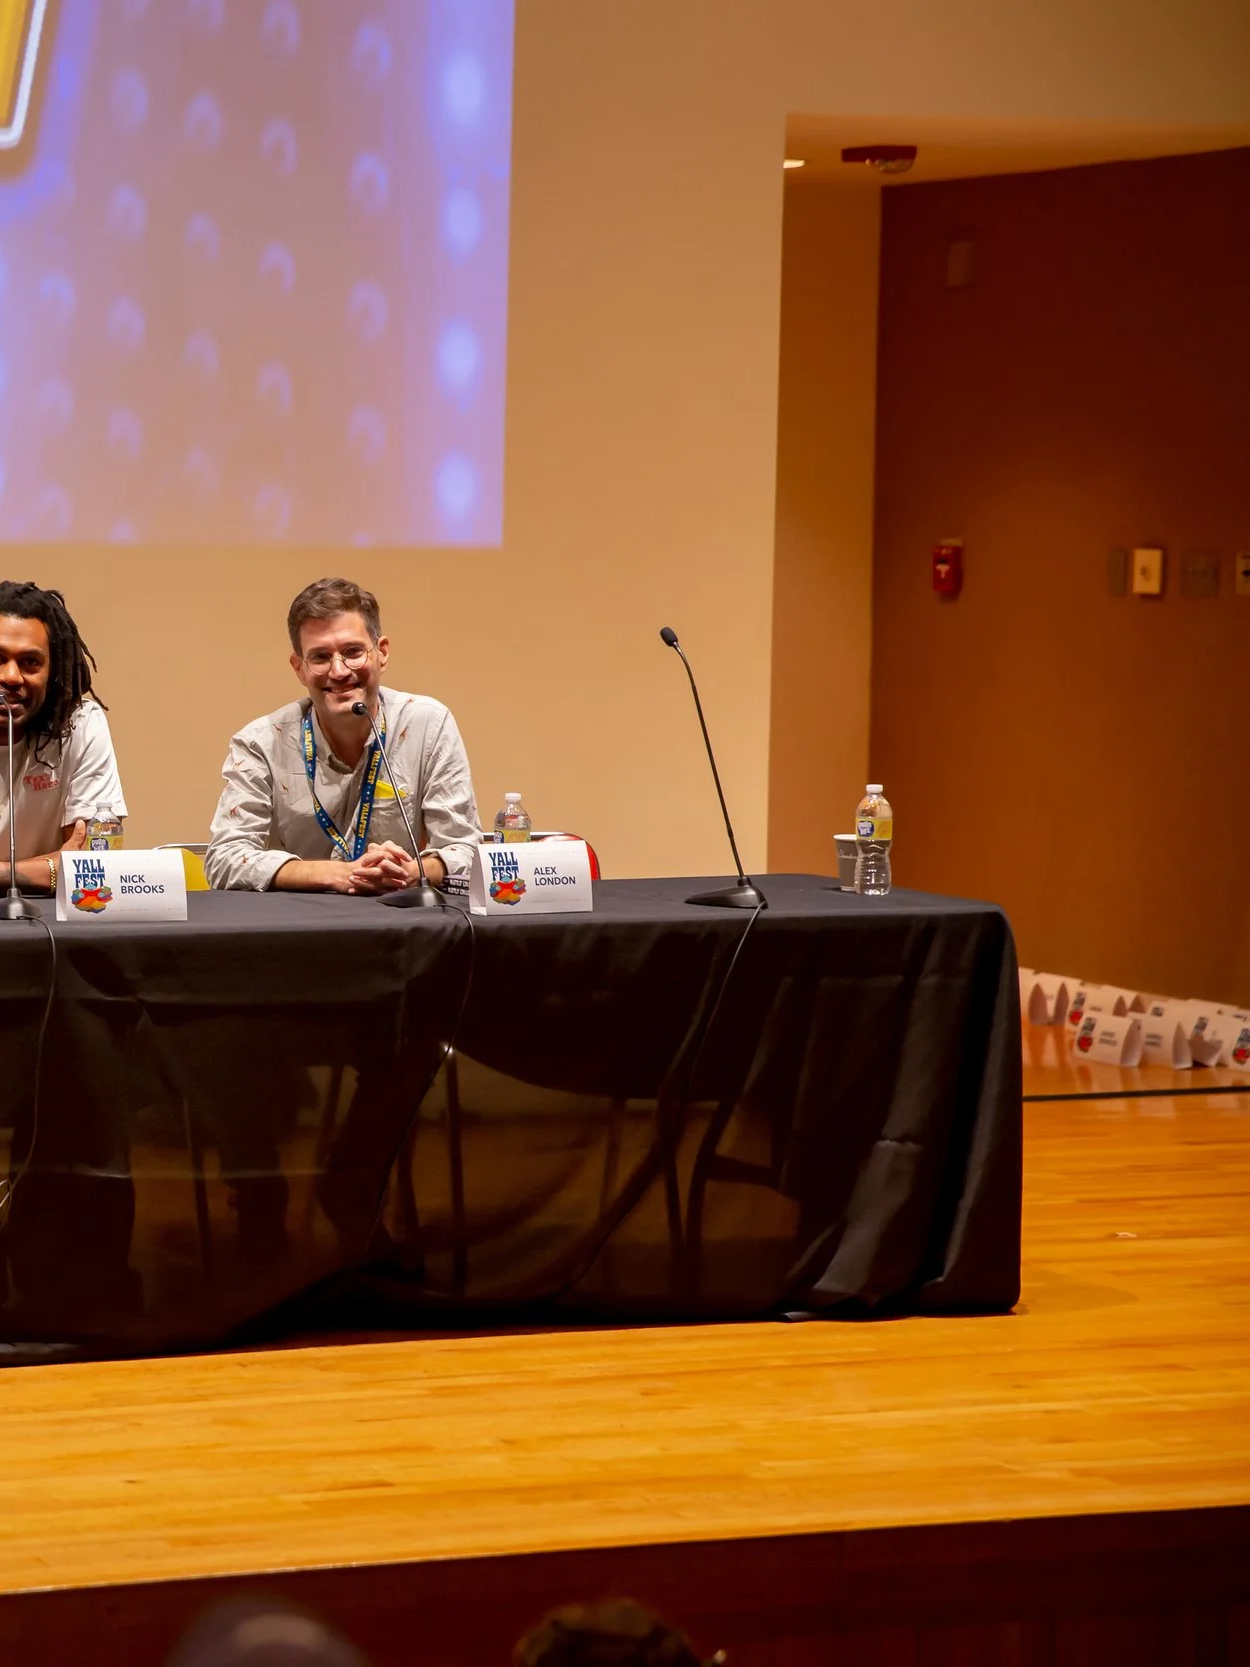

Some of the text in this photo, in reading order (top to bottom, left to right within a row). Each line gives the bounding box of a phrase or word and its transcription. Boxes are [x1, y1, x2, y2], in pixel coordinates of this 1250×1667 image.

[488, 851, 519, 866] YALL
[72, 859, 105, 873] YALL
[533, 866, 557, 876] ALEX
[120, 874, 146, 884] NICK
[491, 866, 520, 882] FEST
[75, 873, 106, 889] FEST
[535, 876, 576, 886] LONDON
[121, 884, 165, 894] BROOKS
